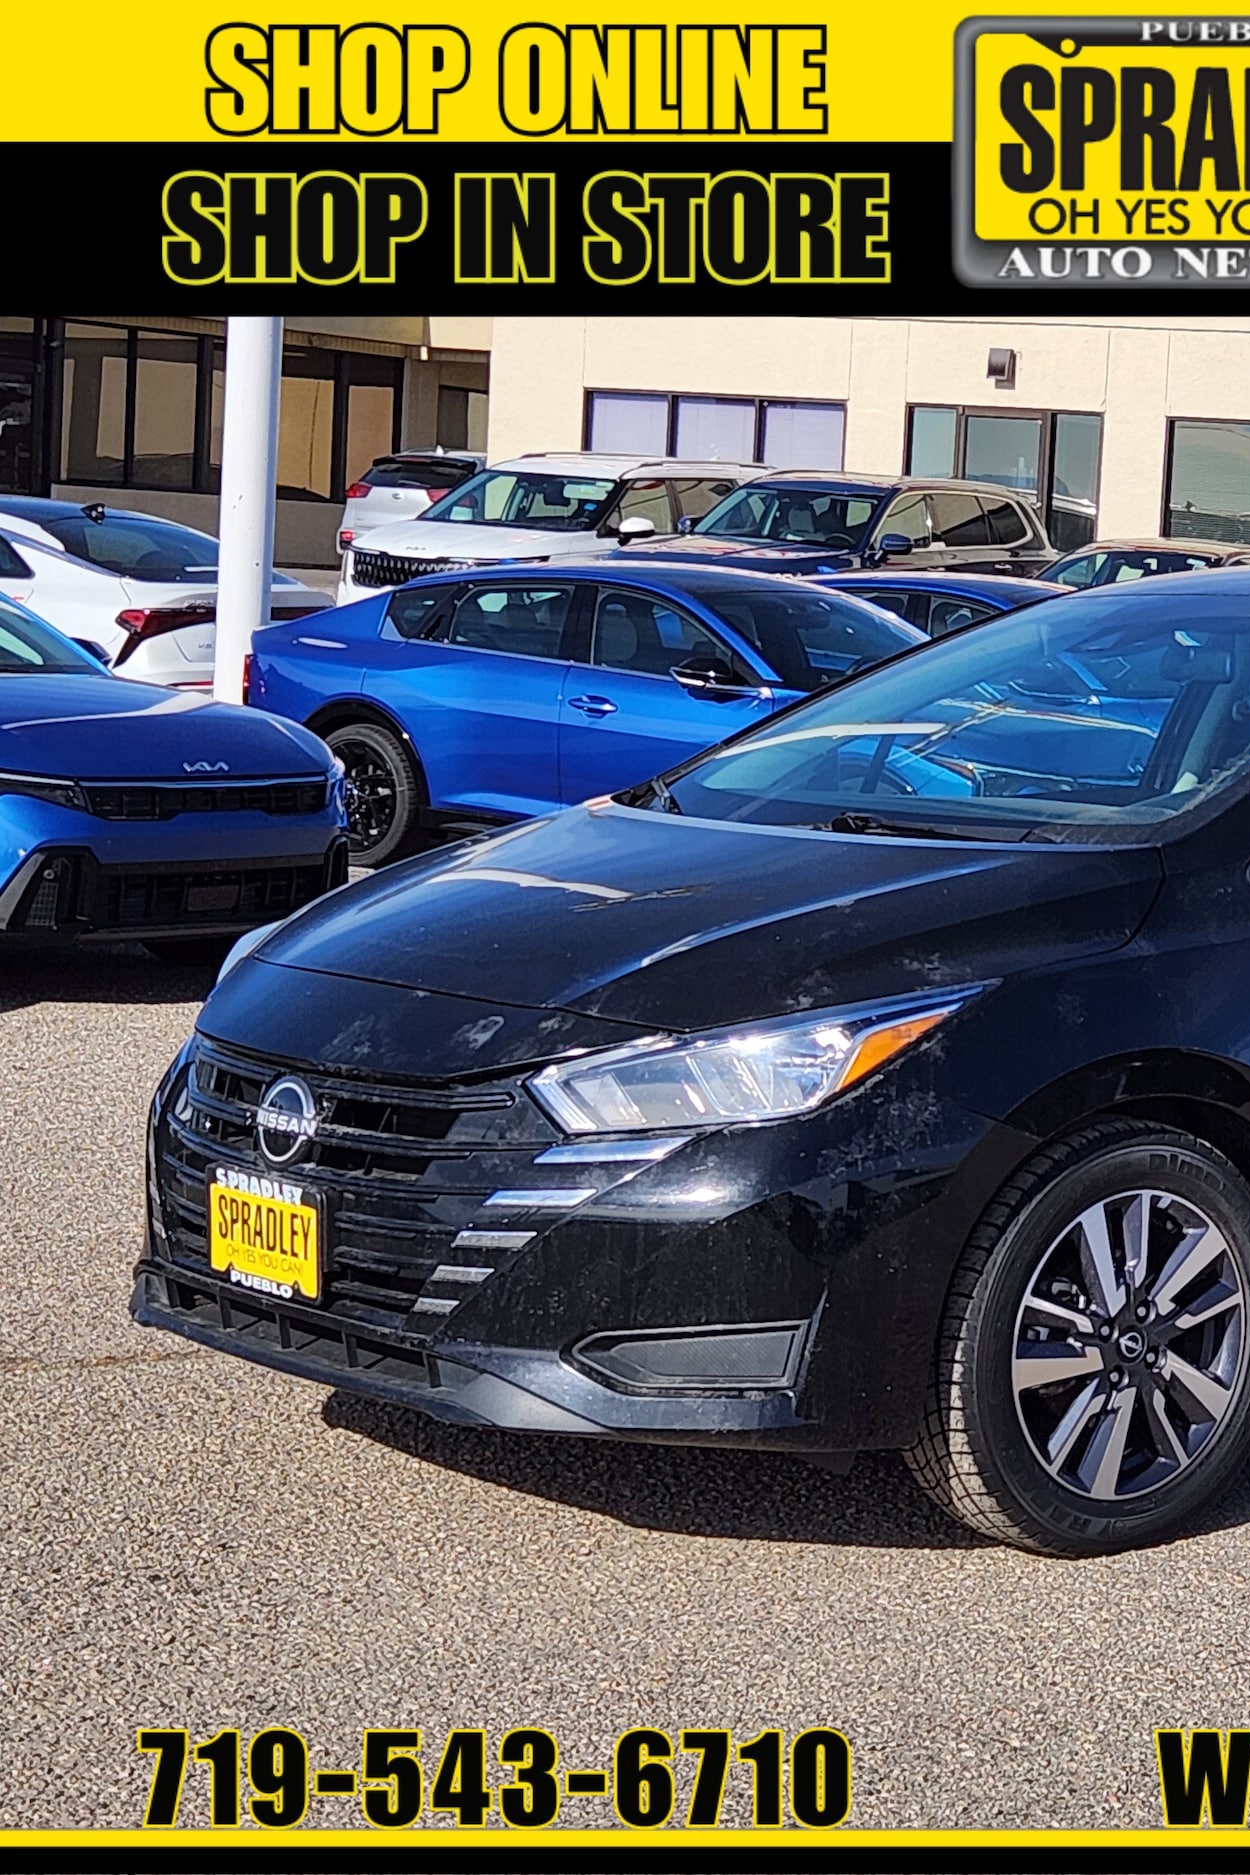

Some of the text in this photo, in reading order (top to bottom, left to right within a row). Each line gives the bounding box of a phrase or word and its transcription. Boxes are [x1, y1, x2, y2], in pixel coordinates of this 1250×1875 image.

[256, 1108, 316, 1138] NISSAN
[215, 1167, 303, 1206] SPRADLEY
[218, 1194, 312, 1261] SPRADLEY
[230, 1268, 293, 1299] PUEBLO
